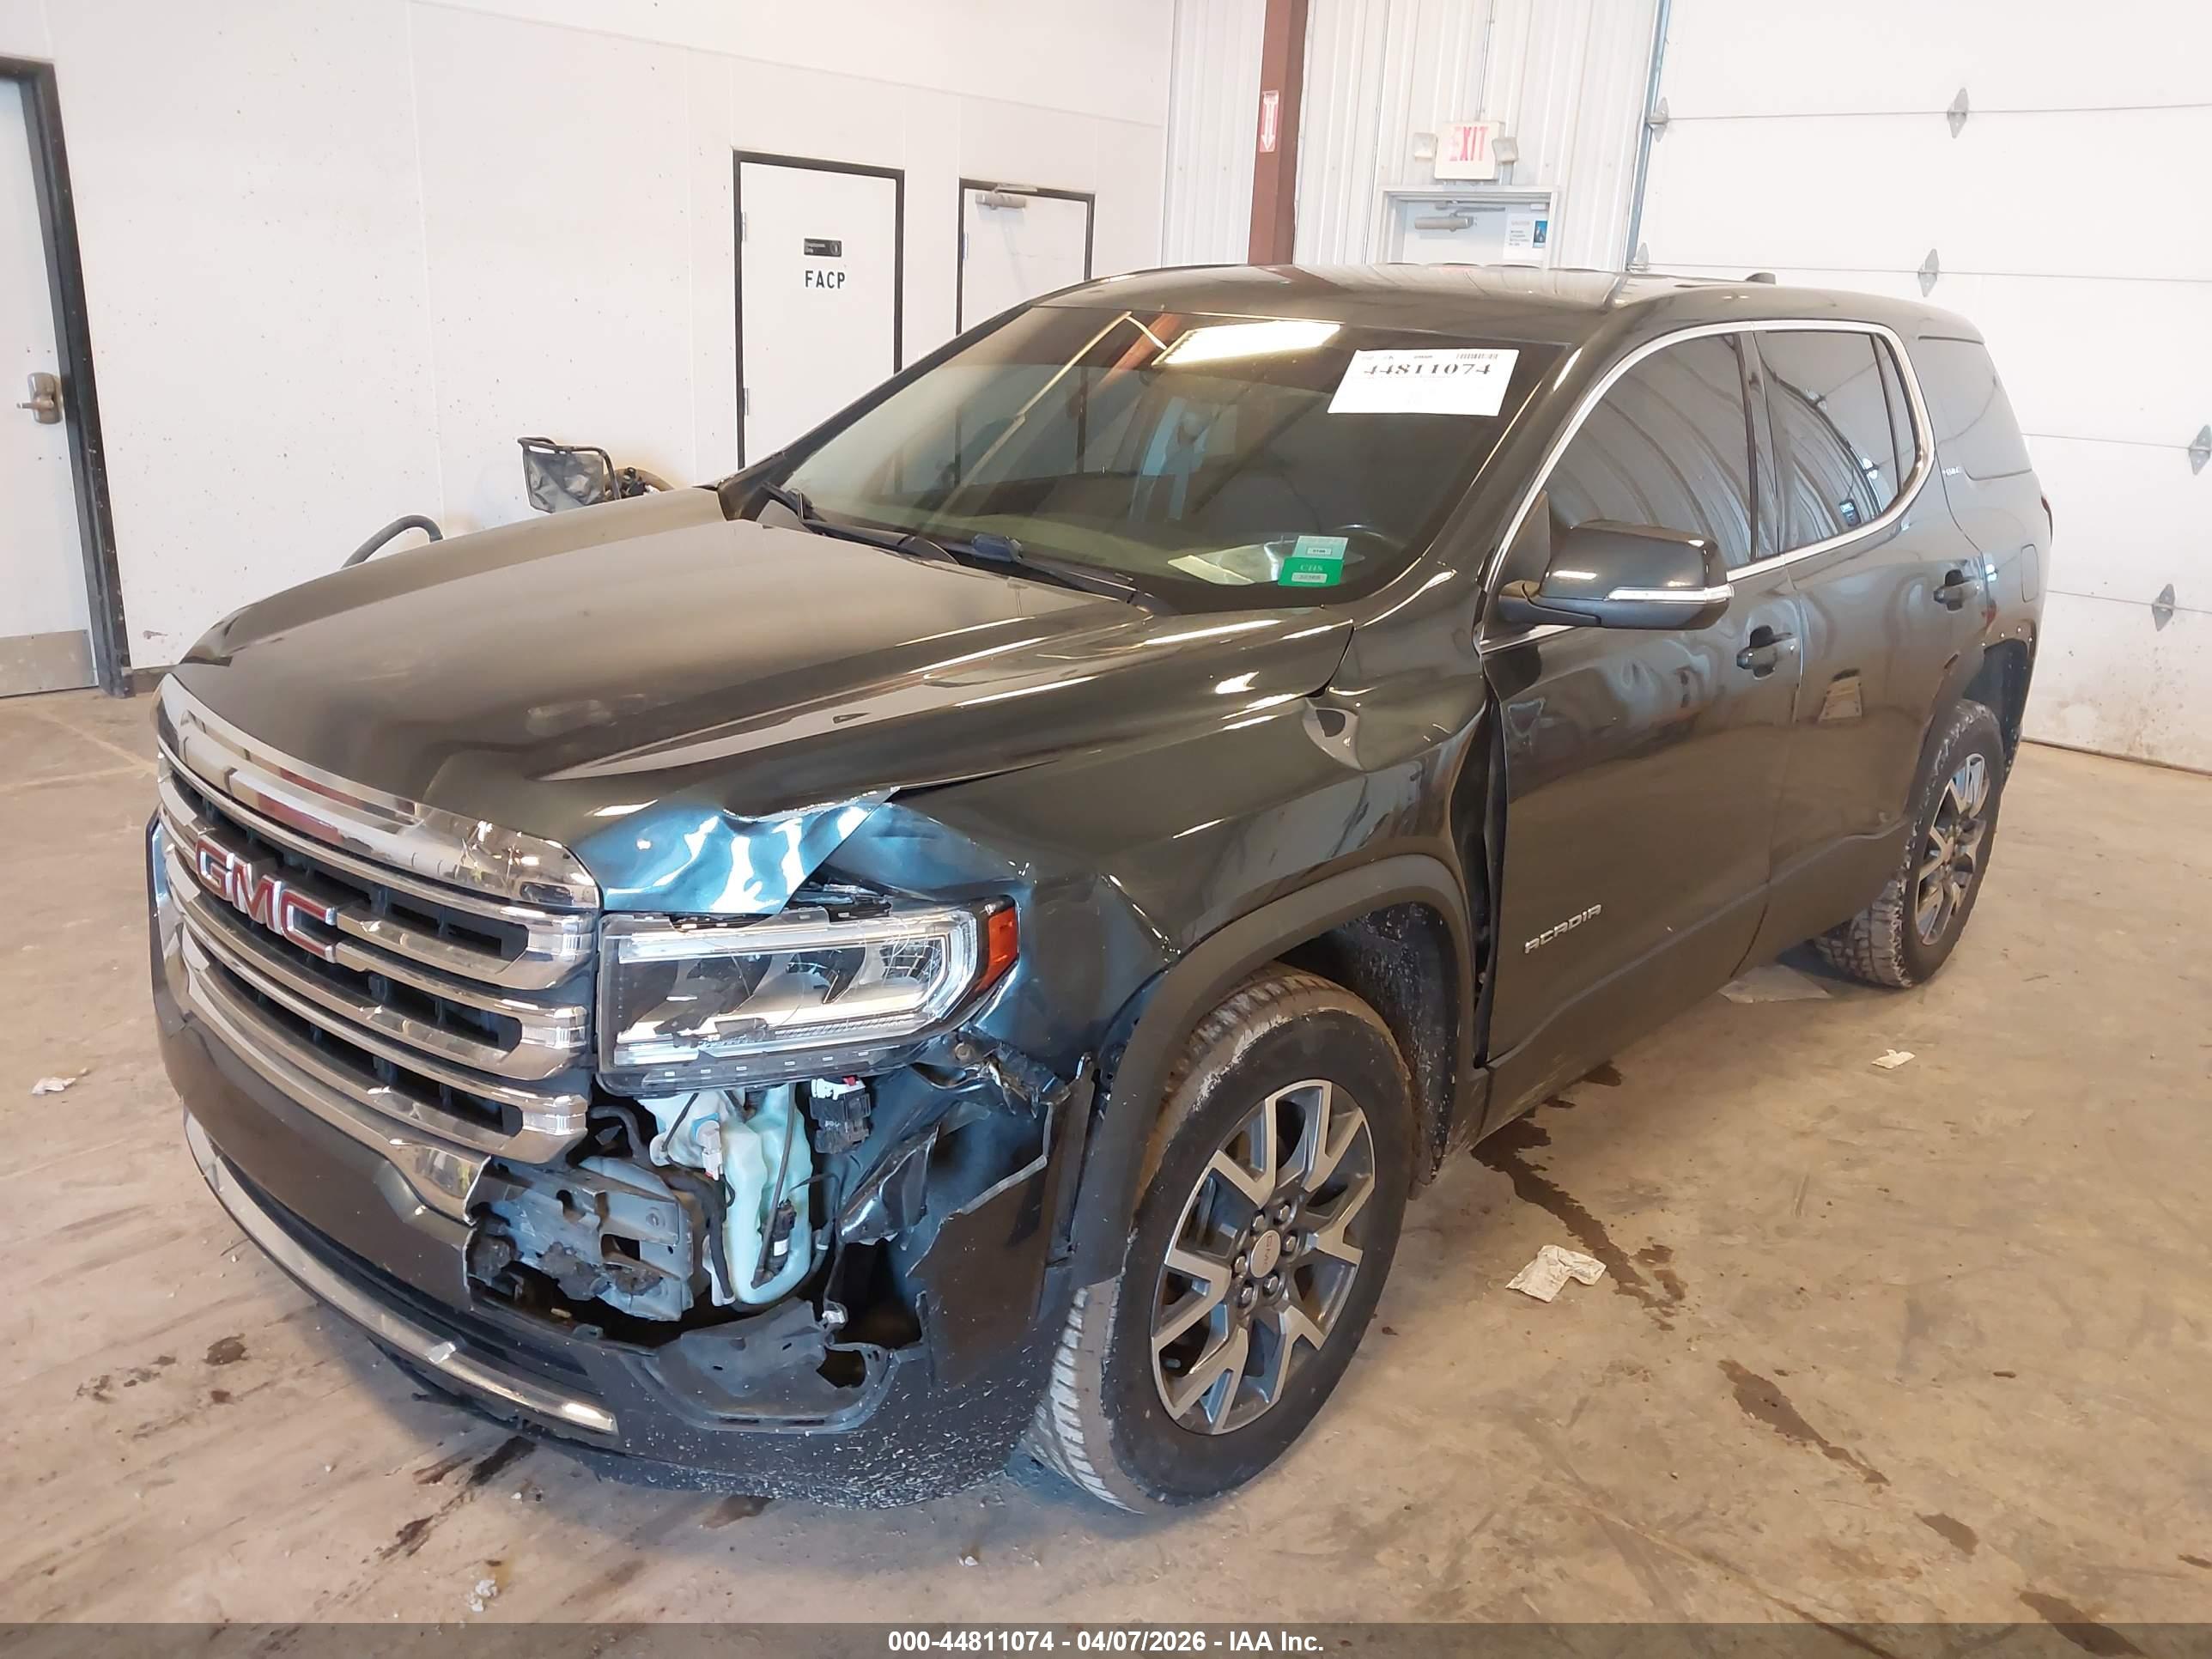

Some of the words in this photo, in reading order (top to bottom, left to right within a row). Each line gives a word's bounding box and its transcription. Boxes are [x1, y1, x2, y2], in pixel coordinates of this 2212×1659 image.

[1449, 126, 1489, 161] EXIT
[805, 270, 845, 289] FACP
[1364, 363, 1491, 375] 44811074
[196, 835, 337, 963] GMC
[1524, 903, 1601, 954] ACADIA
